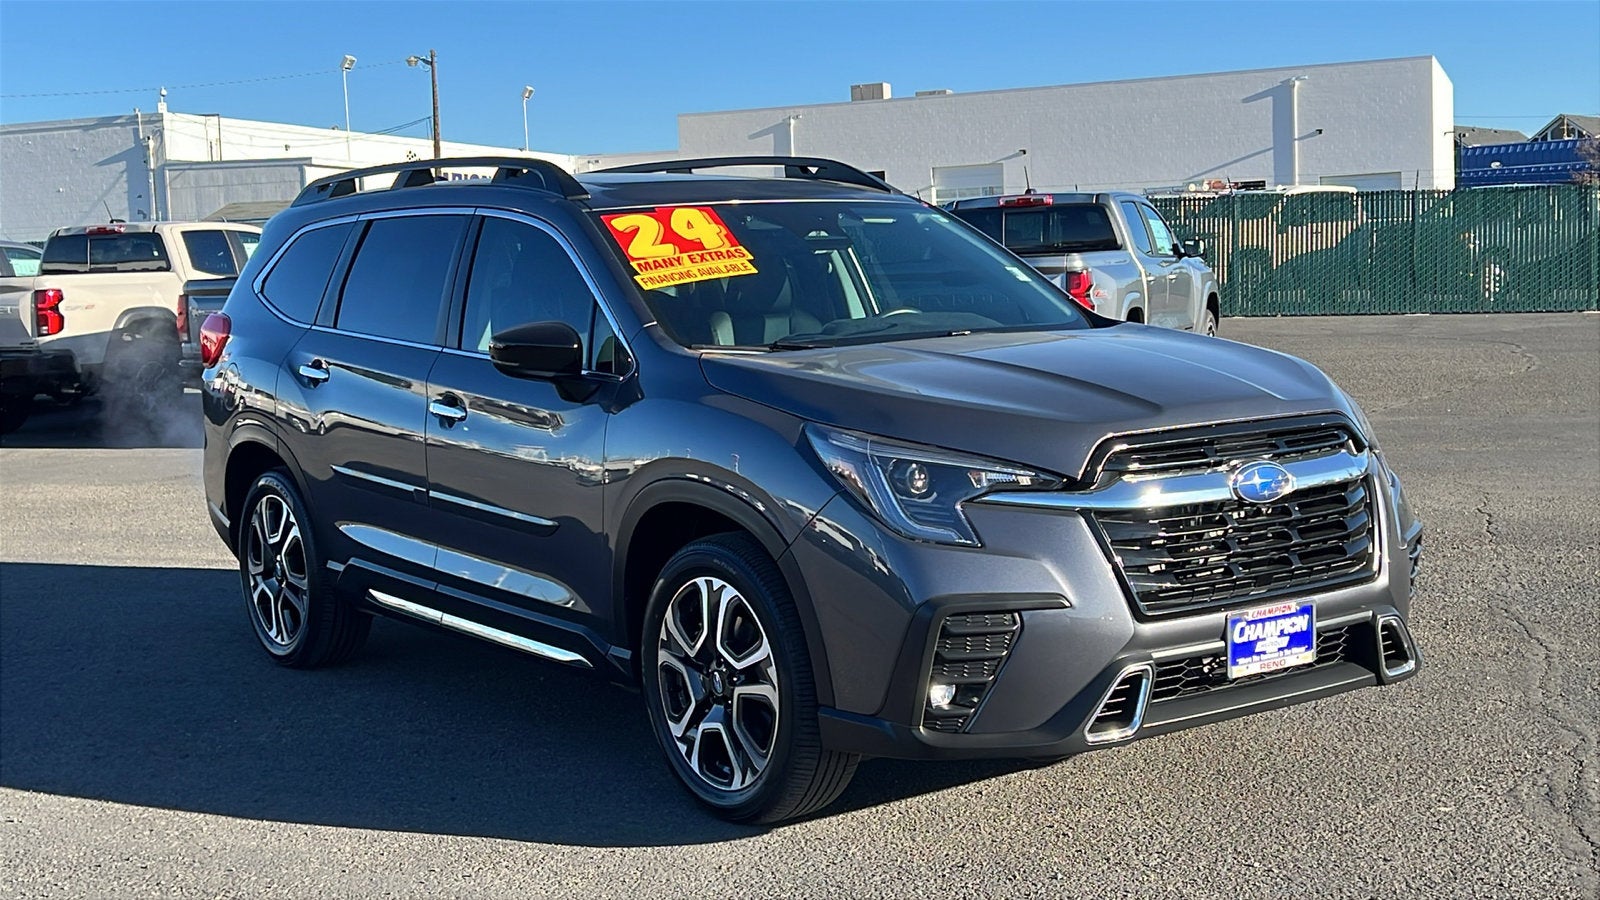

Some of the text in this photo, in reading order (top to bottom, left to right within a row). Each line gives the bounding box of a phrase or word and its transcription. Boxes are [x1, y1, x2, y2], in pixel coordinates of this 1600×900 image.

[610, 208, 730, 258] 24
[637, 248, 747, 272] MANY EXTRAS
[640, 263, 752, 287] FINANCING AVAILABLE
[1251, 604, 1293, 619] CHAMPION
[1233, 613, 1309, 644] CHAMPION
[1259, 659, 1286, 670] RENO
